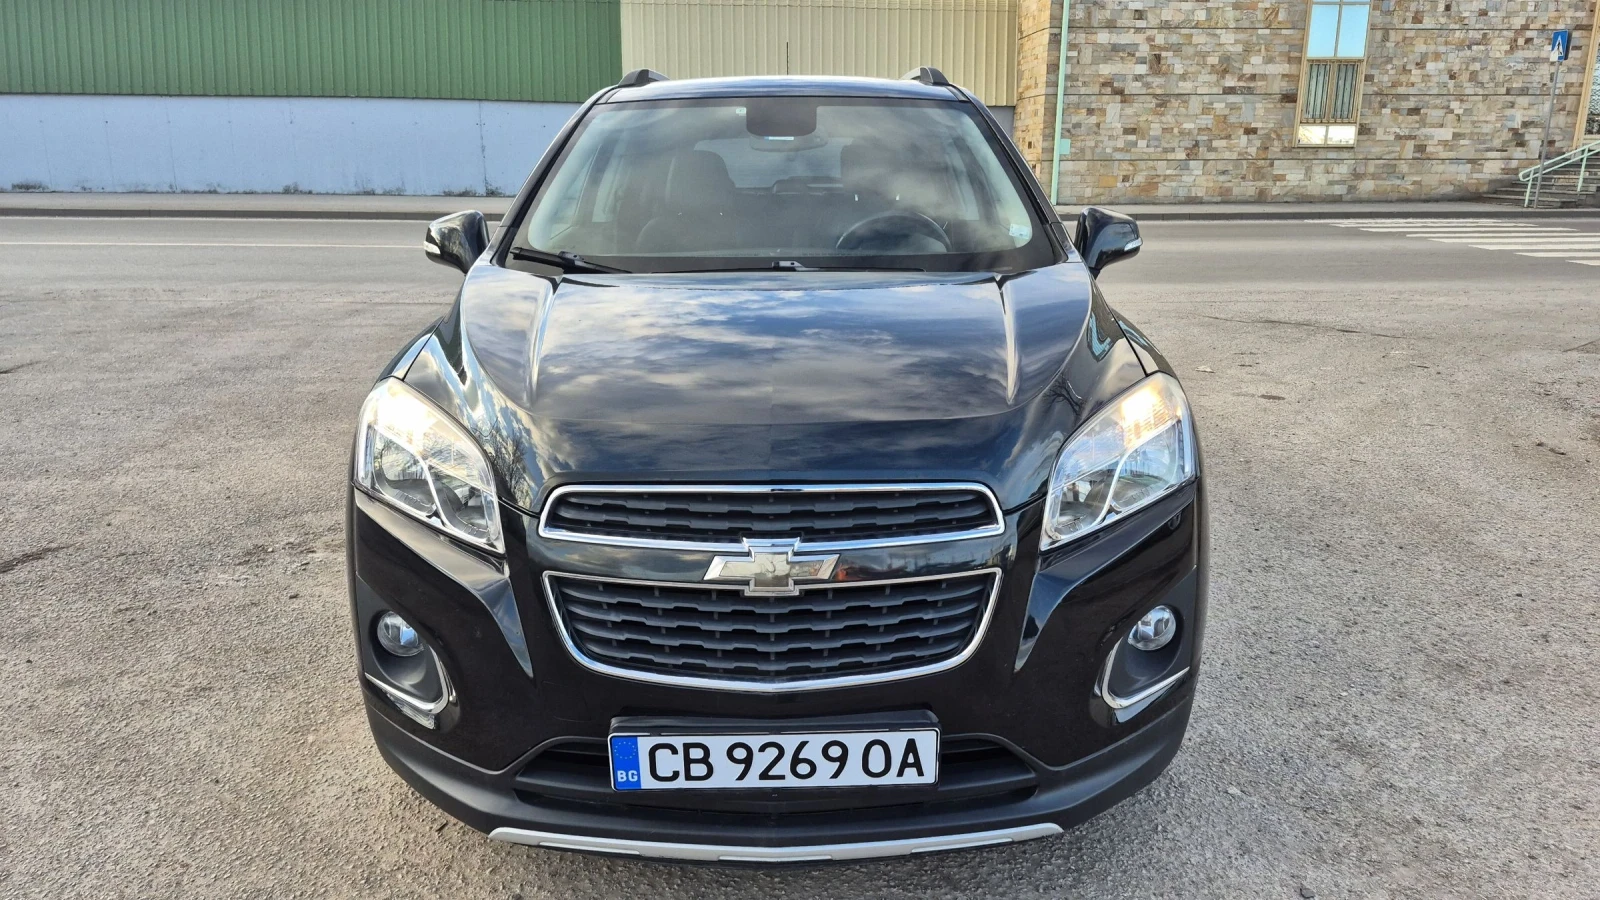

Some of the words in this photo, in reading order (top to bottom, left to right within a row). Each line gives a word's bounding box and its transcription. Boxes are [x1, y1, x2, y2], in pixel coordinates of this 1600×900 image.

[648, 742, 714, 782] CB
[726, 740, 849, 781] 9269
[616, 770, 638, 782] BG
